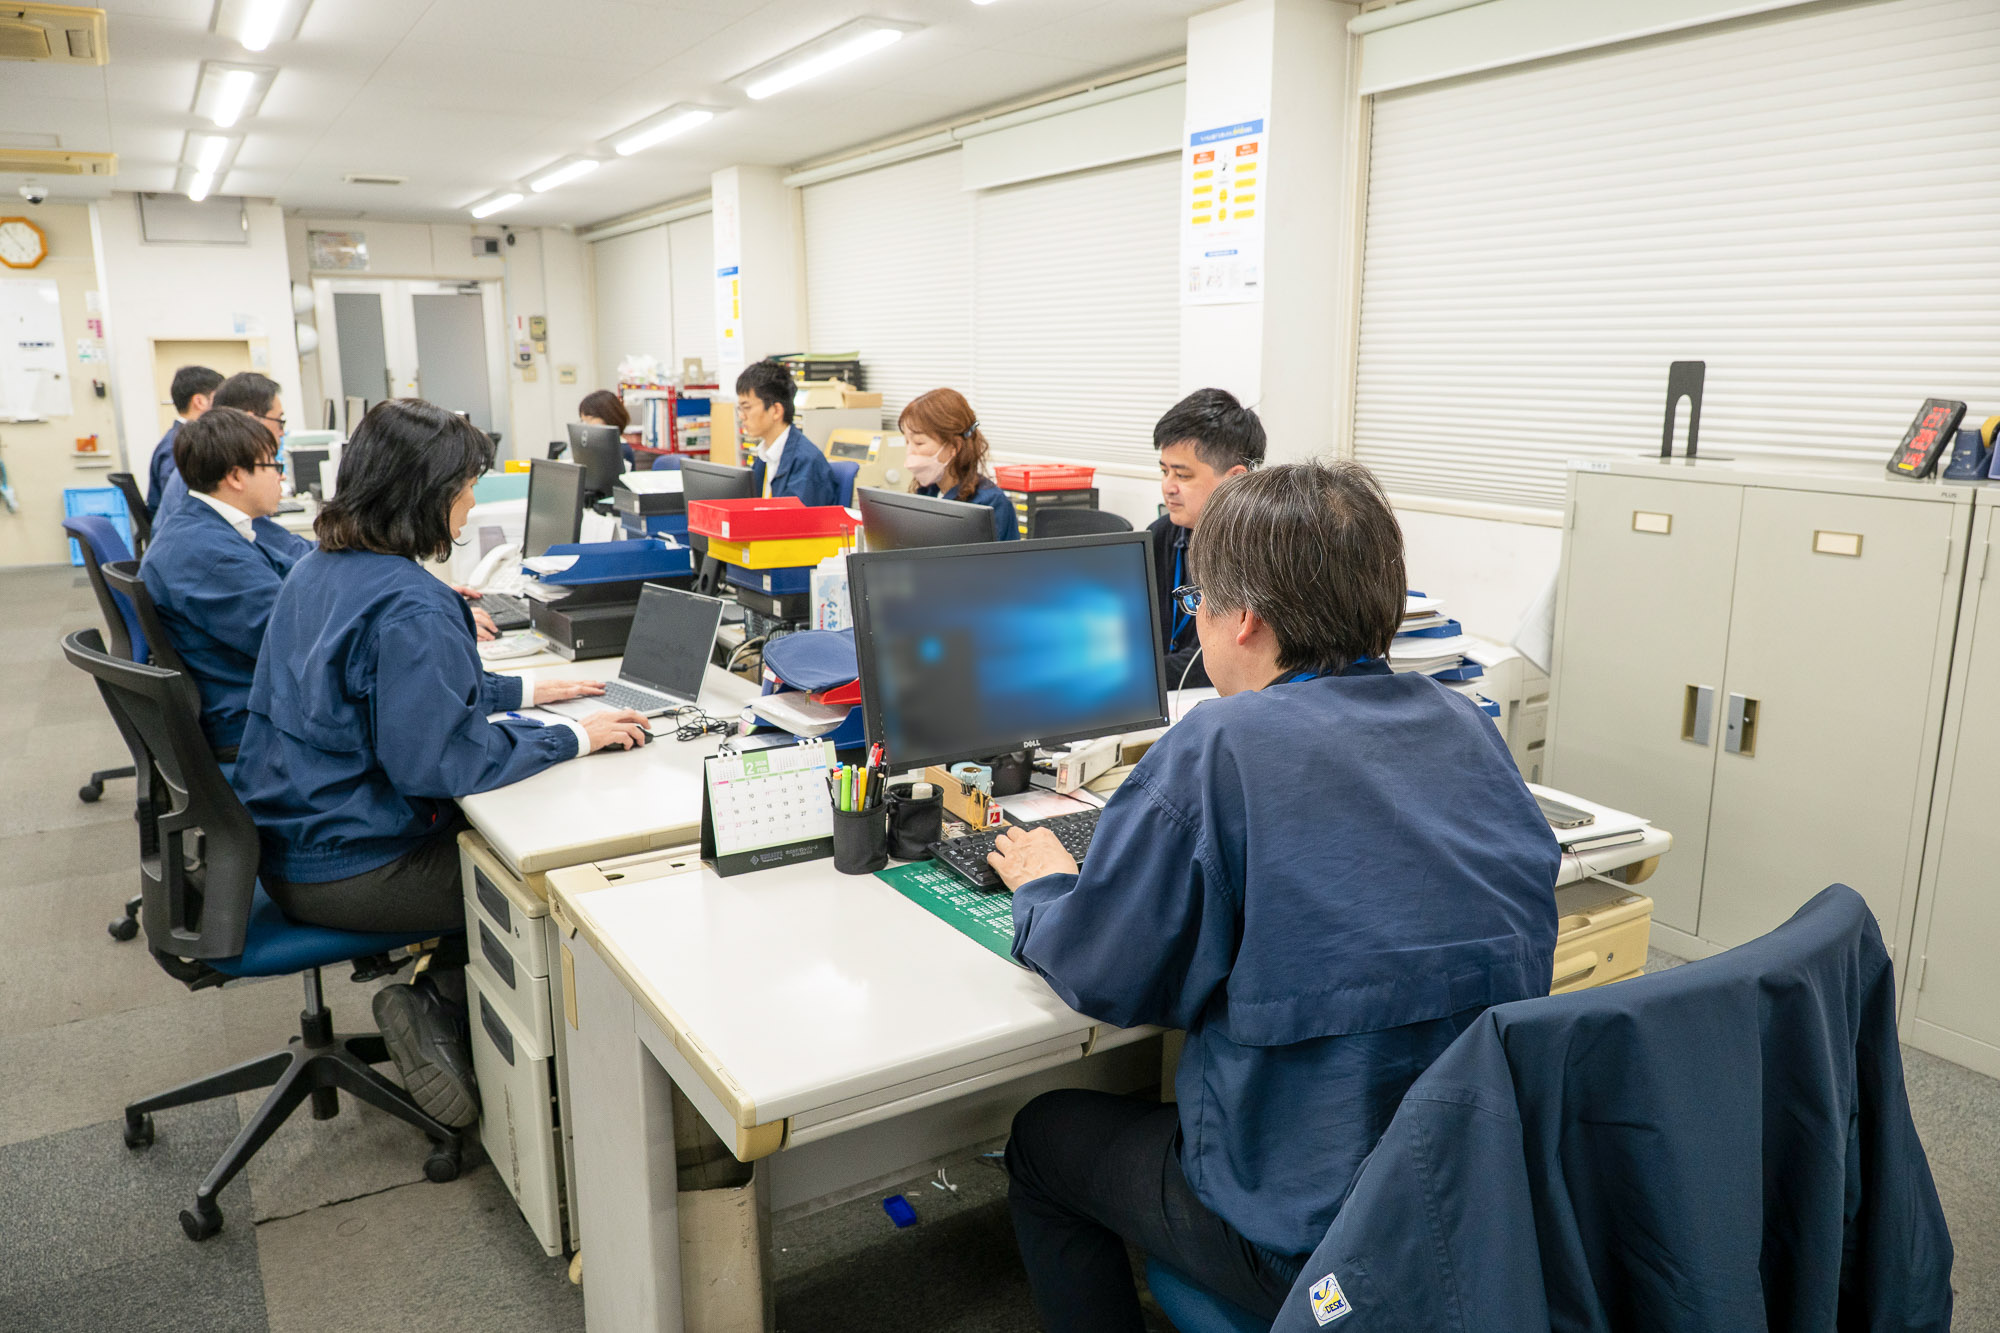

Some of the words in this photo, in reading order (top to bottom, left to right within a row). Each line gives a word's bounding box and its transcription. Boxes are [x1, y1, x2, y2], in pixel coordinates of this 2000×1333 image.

[1024, 740, 1040, 748] DELL
[746, 762, 754, 774] 2
[1325, 1300, 1344, 1313] DESK
